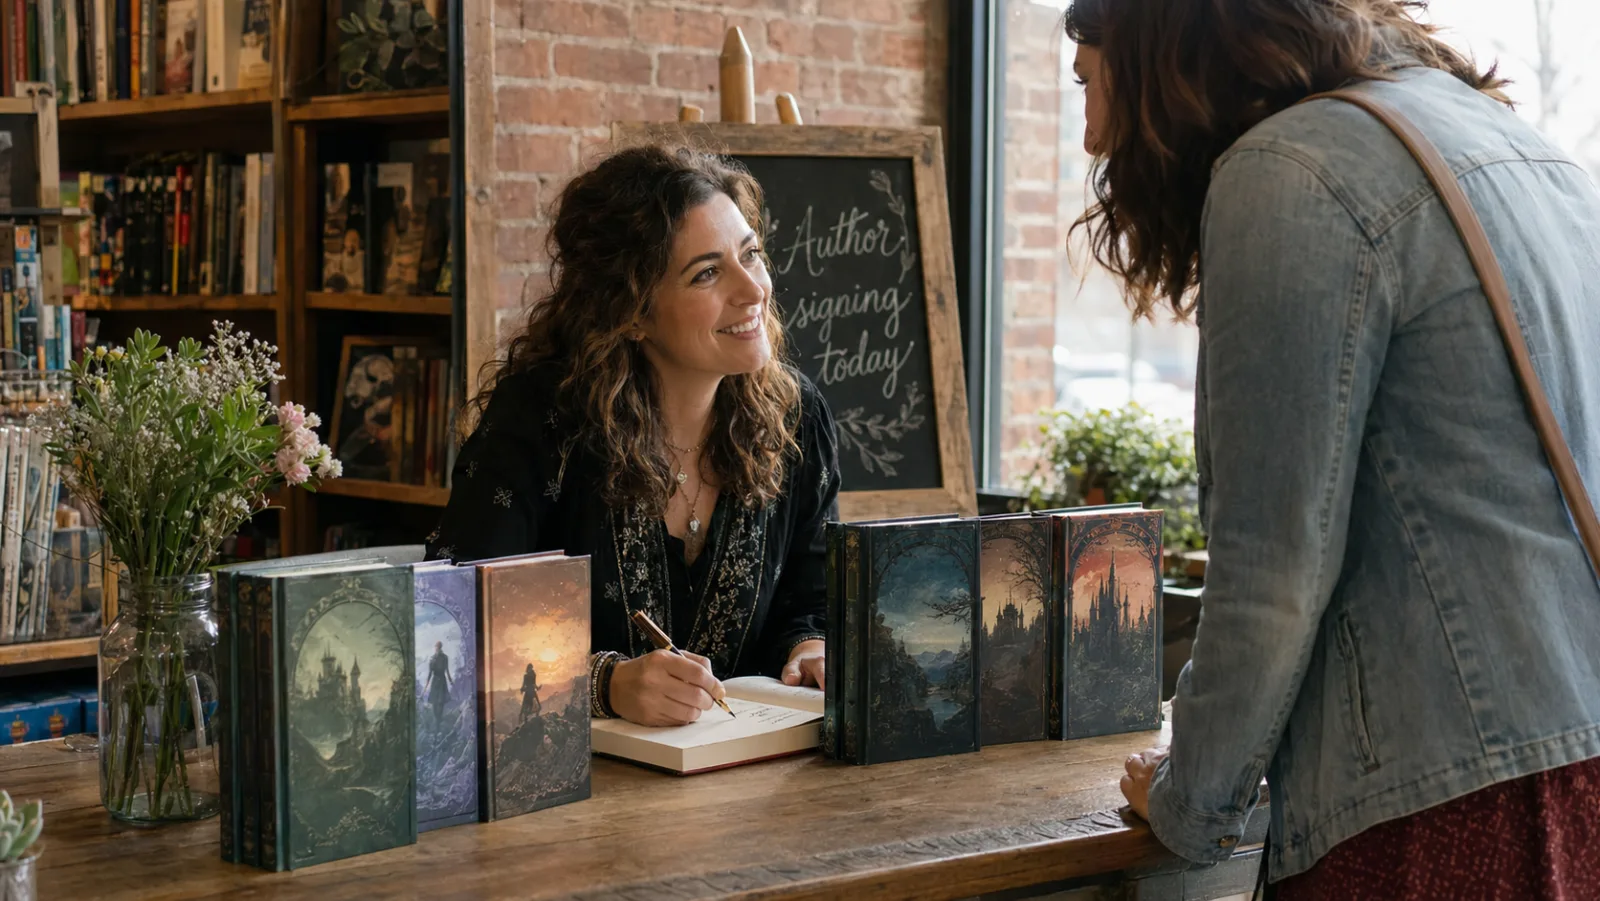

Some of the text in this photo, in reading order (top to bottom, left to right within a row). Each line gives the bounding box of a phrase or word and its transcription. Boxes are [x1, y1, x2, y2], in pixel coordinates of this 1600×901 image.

[777, 205, 905, 277] Author
[786, 284, 912, 343] signing
[813, 329, 915, 399] today
